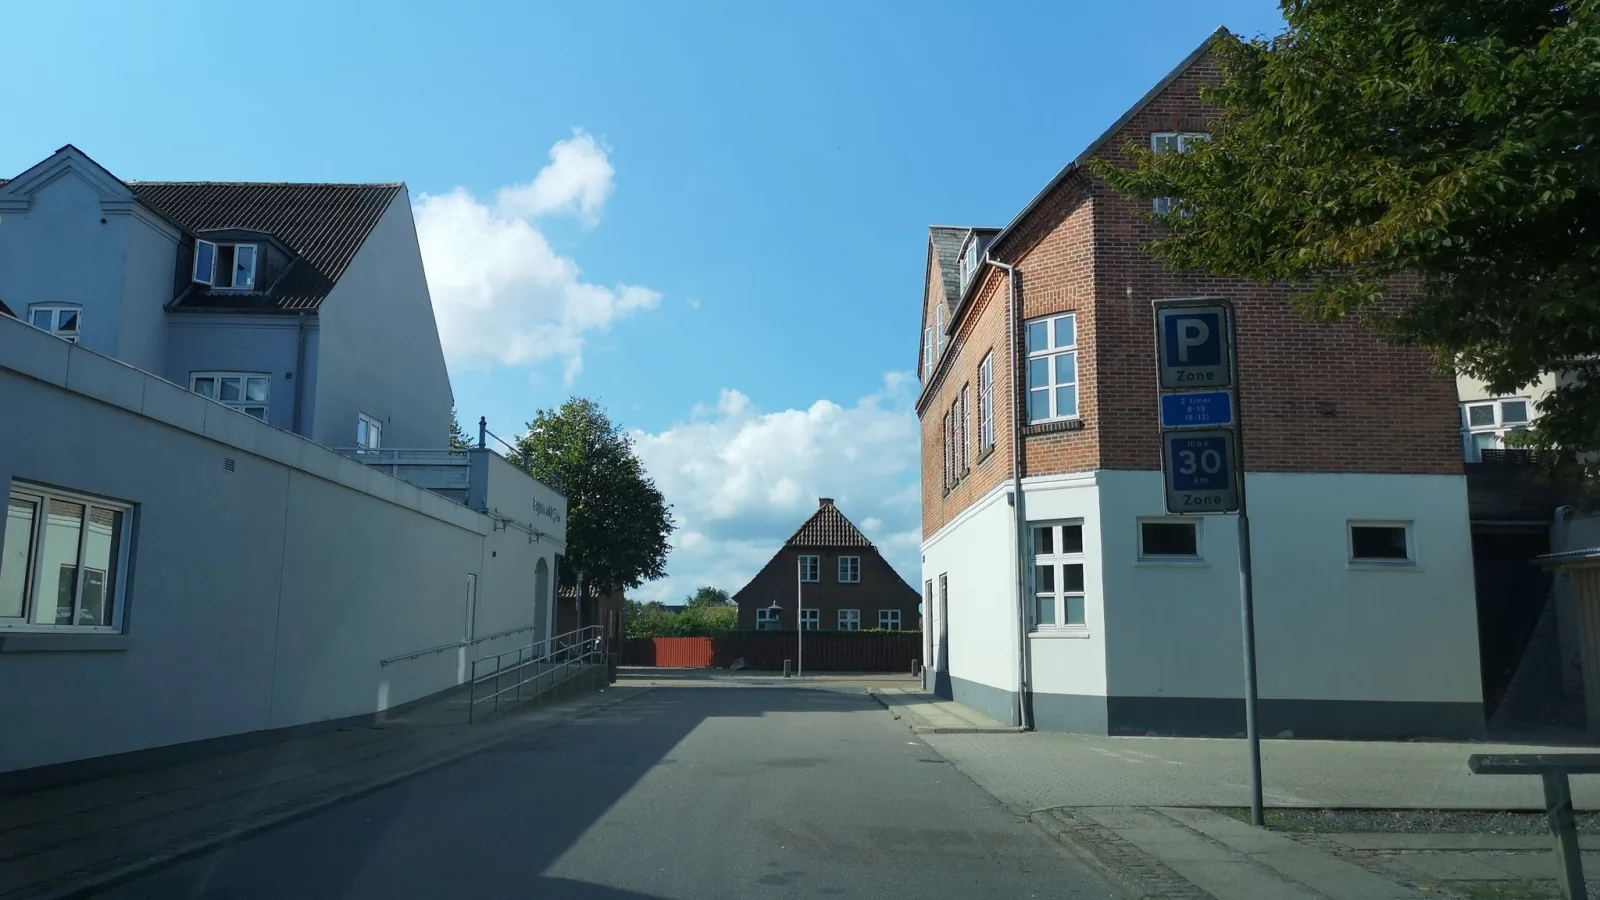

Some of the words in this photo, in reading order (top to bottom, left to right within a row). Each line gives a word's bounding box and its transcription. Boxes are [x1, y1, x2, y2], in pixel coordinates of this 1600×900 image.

[1176, 318, 1210, 362] P
[1176, 370, 1214, 381] Zone
[1189, 397, 1212, 405] timer
[1187, 440, 1209, 448] max
[1178, 449, 1221, 475] 30
[1193, 475, 1209, 485] km
[1183, 494, 1222, 506] Zone
